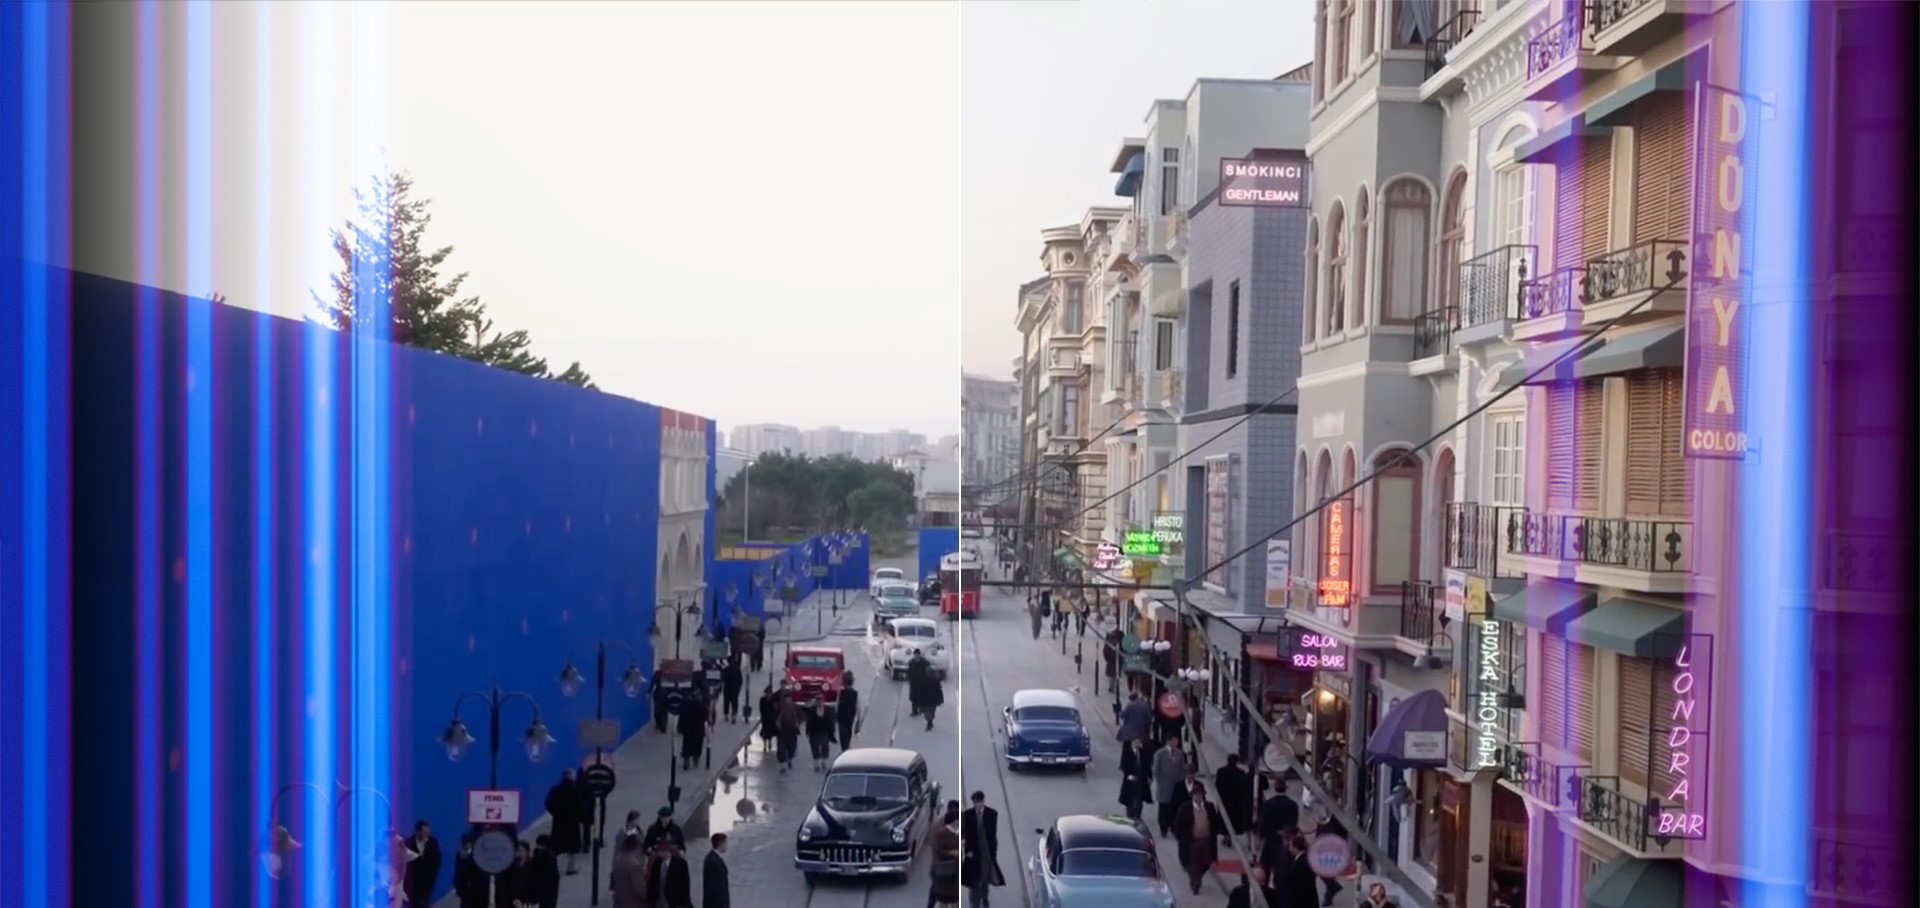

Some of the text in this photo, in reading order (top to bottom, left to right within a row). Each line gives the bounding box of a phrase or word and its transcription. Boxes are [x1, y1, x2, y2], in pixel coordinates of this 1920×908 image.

[1225, 189, 1299, 201] GENTLEMAN
[1705, 92, 1747, 416] DÜNYA
[1690, 430, 1748, 452] COLOR
[1154, 516, 1182, 527] HRISTO
[1152, 531, 1183, 542] PERUKA
[1329, 502, 1342, 576] CAMERAS
[1301, 635, 1337, 648] SALON
[1478, 620, 1499, 767] ESKA HOTEL
[1668, 646, 1695, 801] LONDRA
[1658, 813, 1704, 836] BAR
